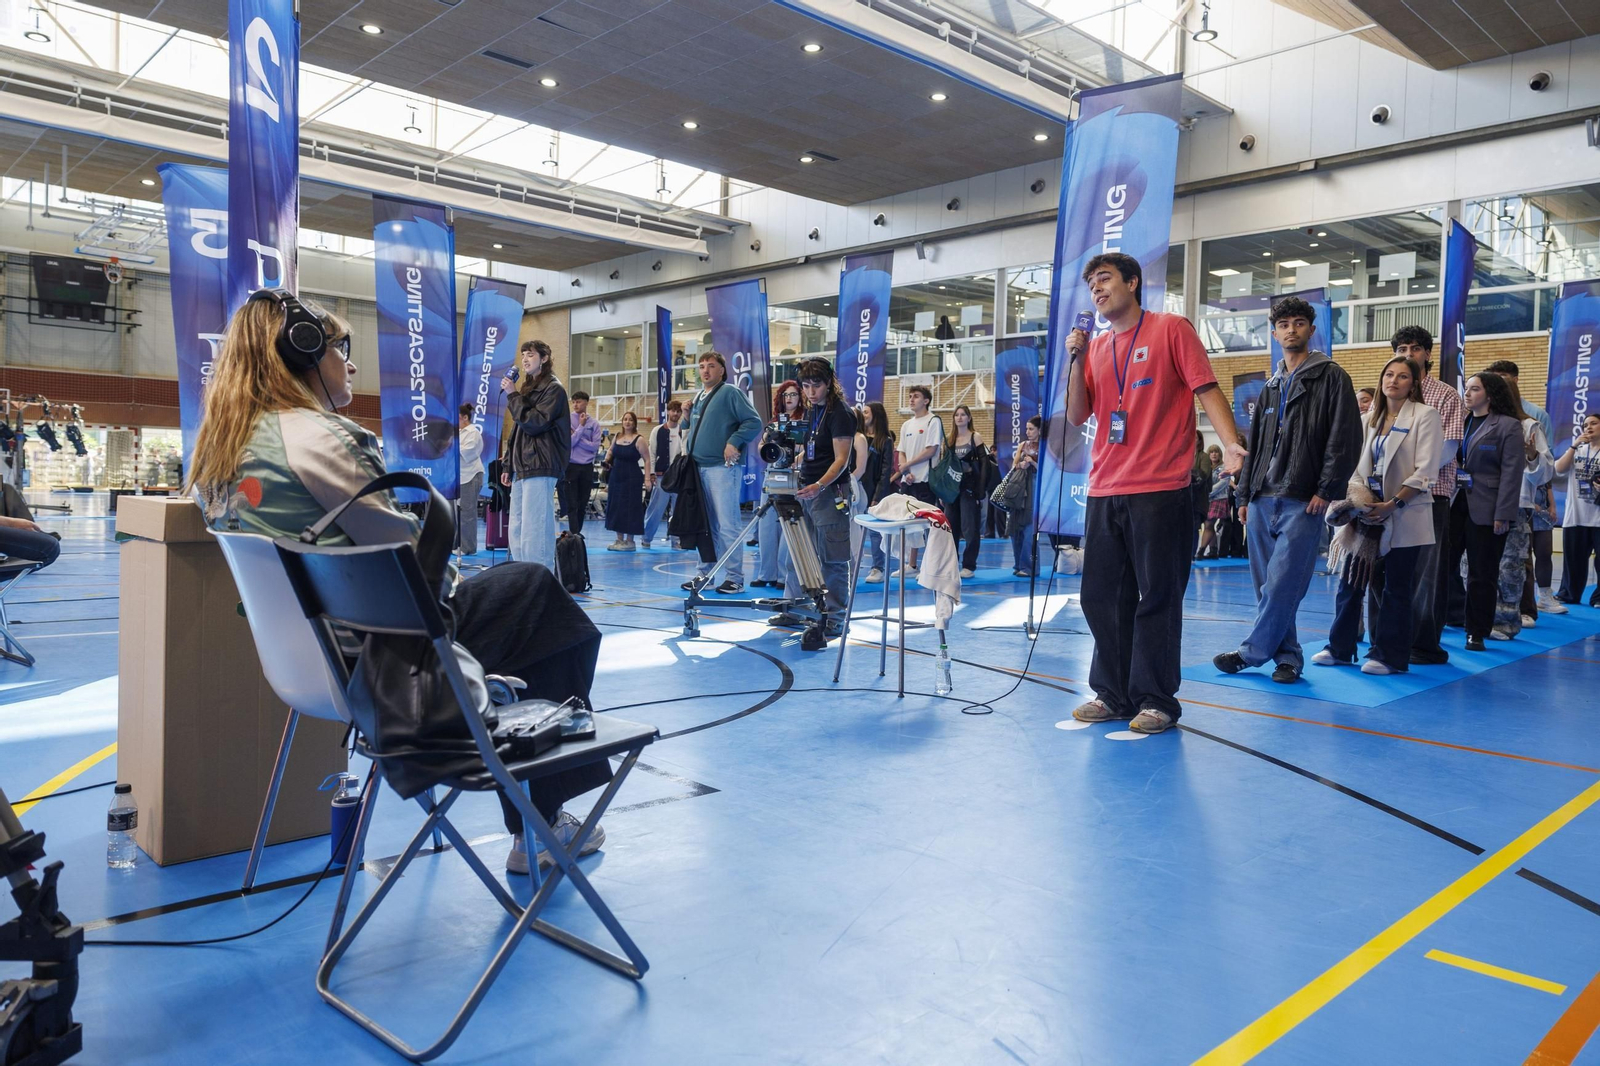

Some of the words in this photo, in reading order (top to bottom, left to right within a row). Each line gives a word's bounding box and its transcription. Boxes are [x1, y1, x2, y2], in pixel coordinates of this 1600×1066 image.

[472, 326, 499, 435] OT25CASTING
[855, 308, 871, 411] 25CASTING
[1070, 483, 1089, 498] pri
